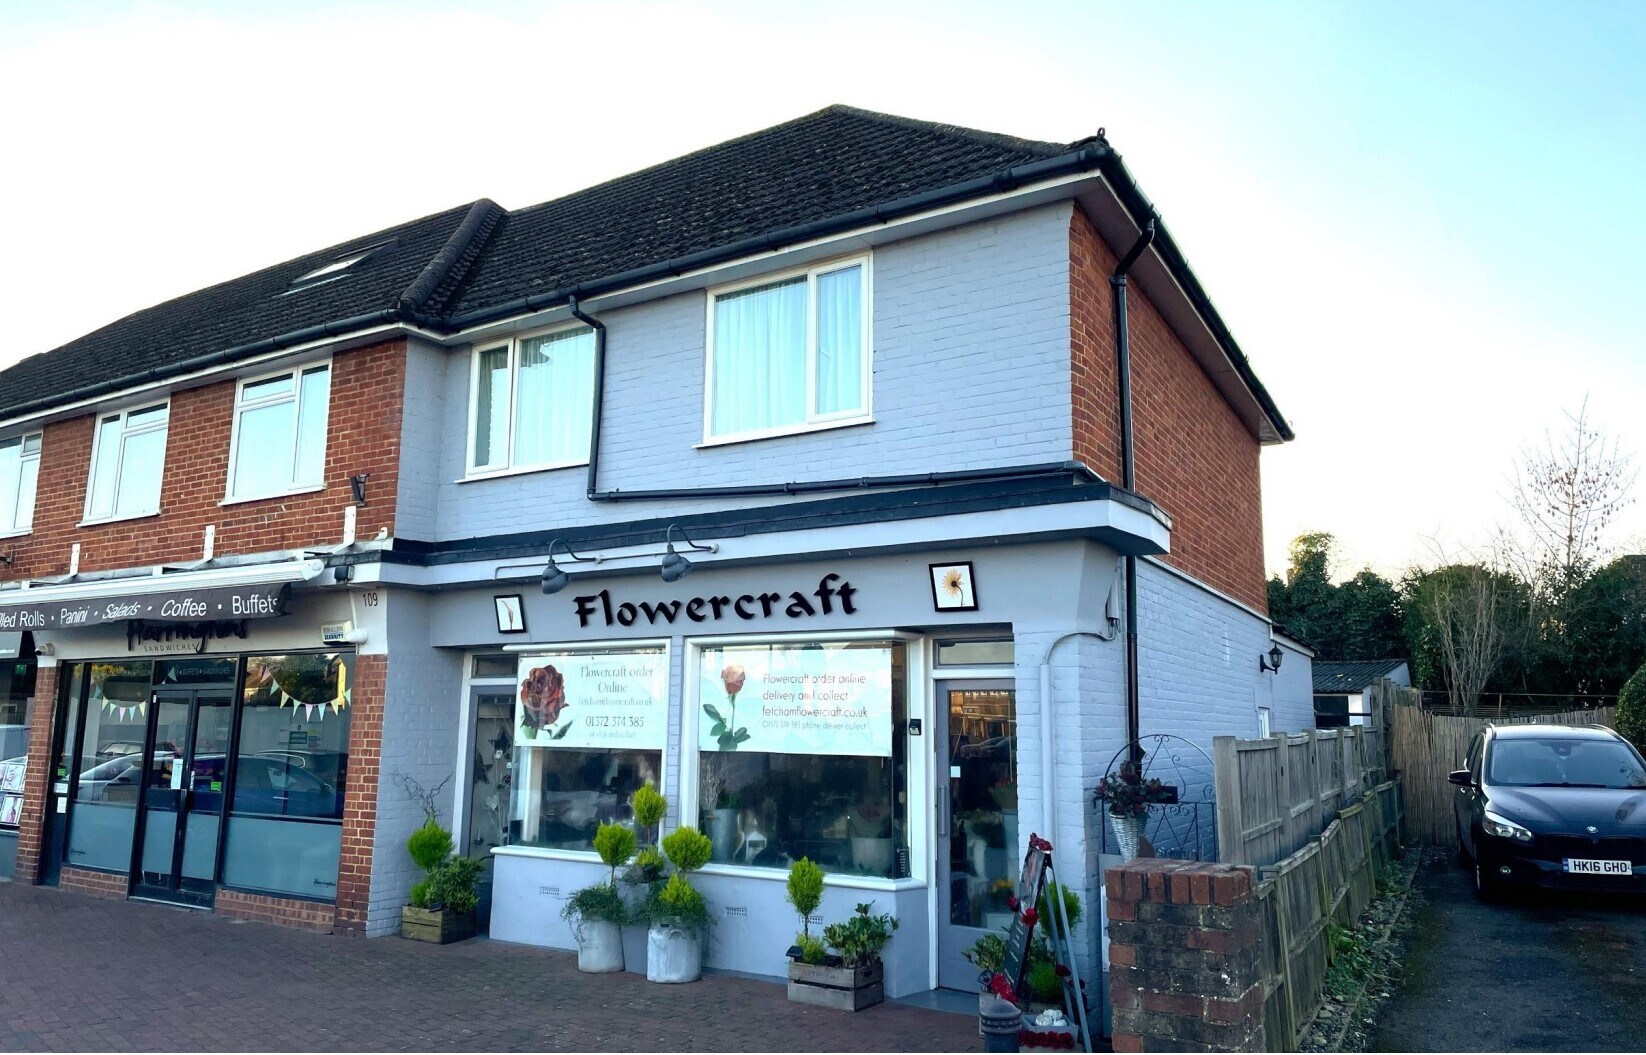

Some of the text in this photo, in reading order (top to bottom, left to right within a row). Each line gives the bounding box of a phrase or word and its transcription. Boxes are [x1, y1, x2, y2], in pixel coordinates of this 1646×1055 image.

[362, 592, 379, 607] 109
[573, 573, 857, 628] Flowercraft
[19, 610, 45, 627] Rolls
[60, 606, 90, 625] Panini
[102, 601, 141, 620] Salads
[161, 598, 207, 617] Coffee
[144, 643, 197, 653] SANDWICHES
[580, 665, 654, 678] Flowercraft order
[763, 673, 866, 684] Flowercraft order online
[598, 681, 628, 693] Online
[762, 690, 848, 702] delivery and collect
[762, 705, 868, 718] fetchamflowercraft.co.uk
[585, 716, 644, 728] 01372 374 385
[1573, 860, 1600, 872] HK16
